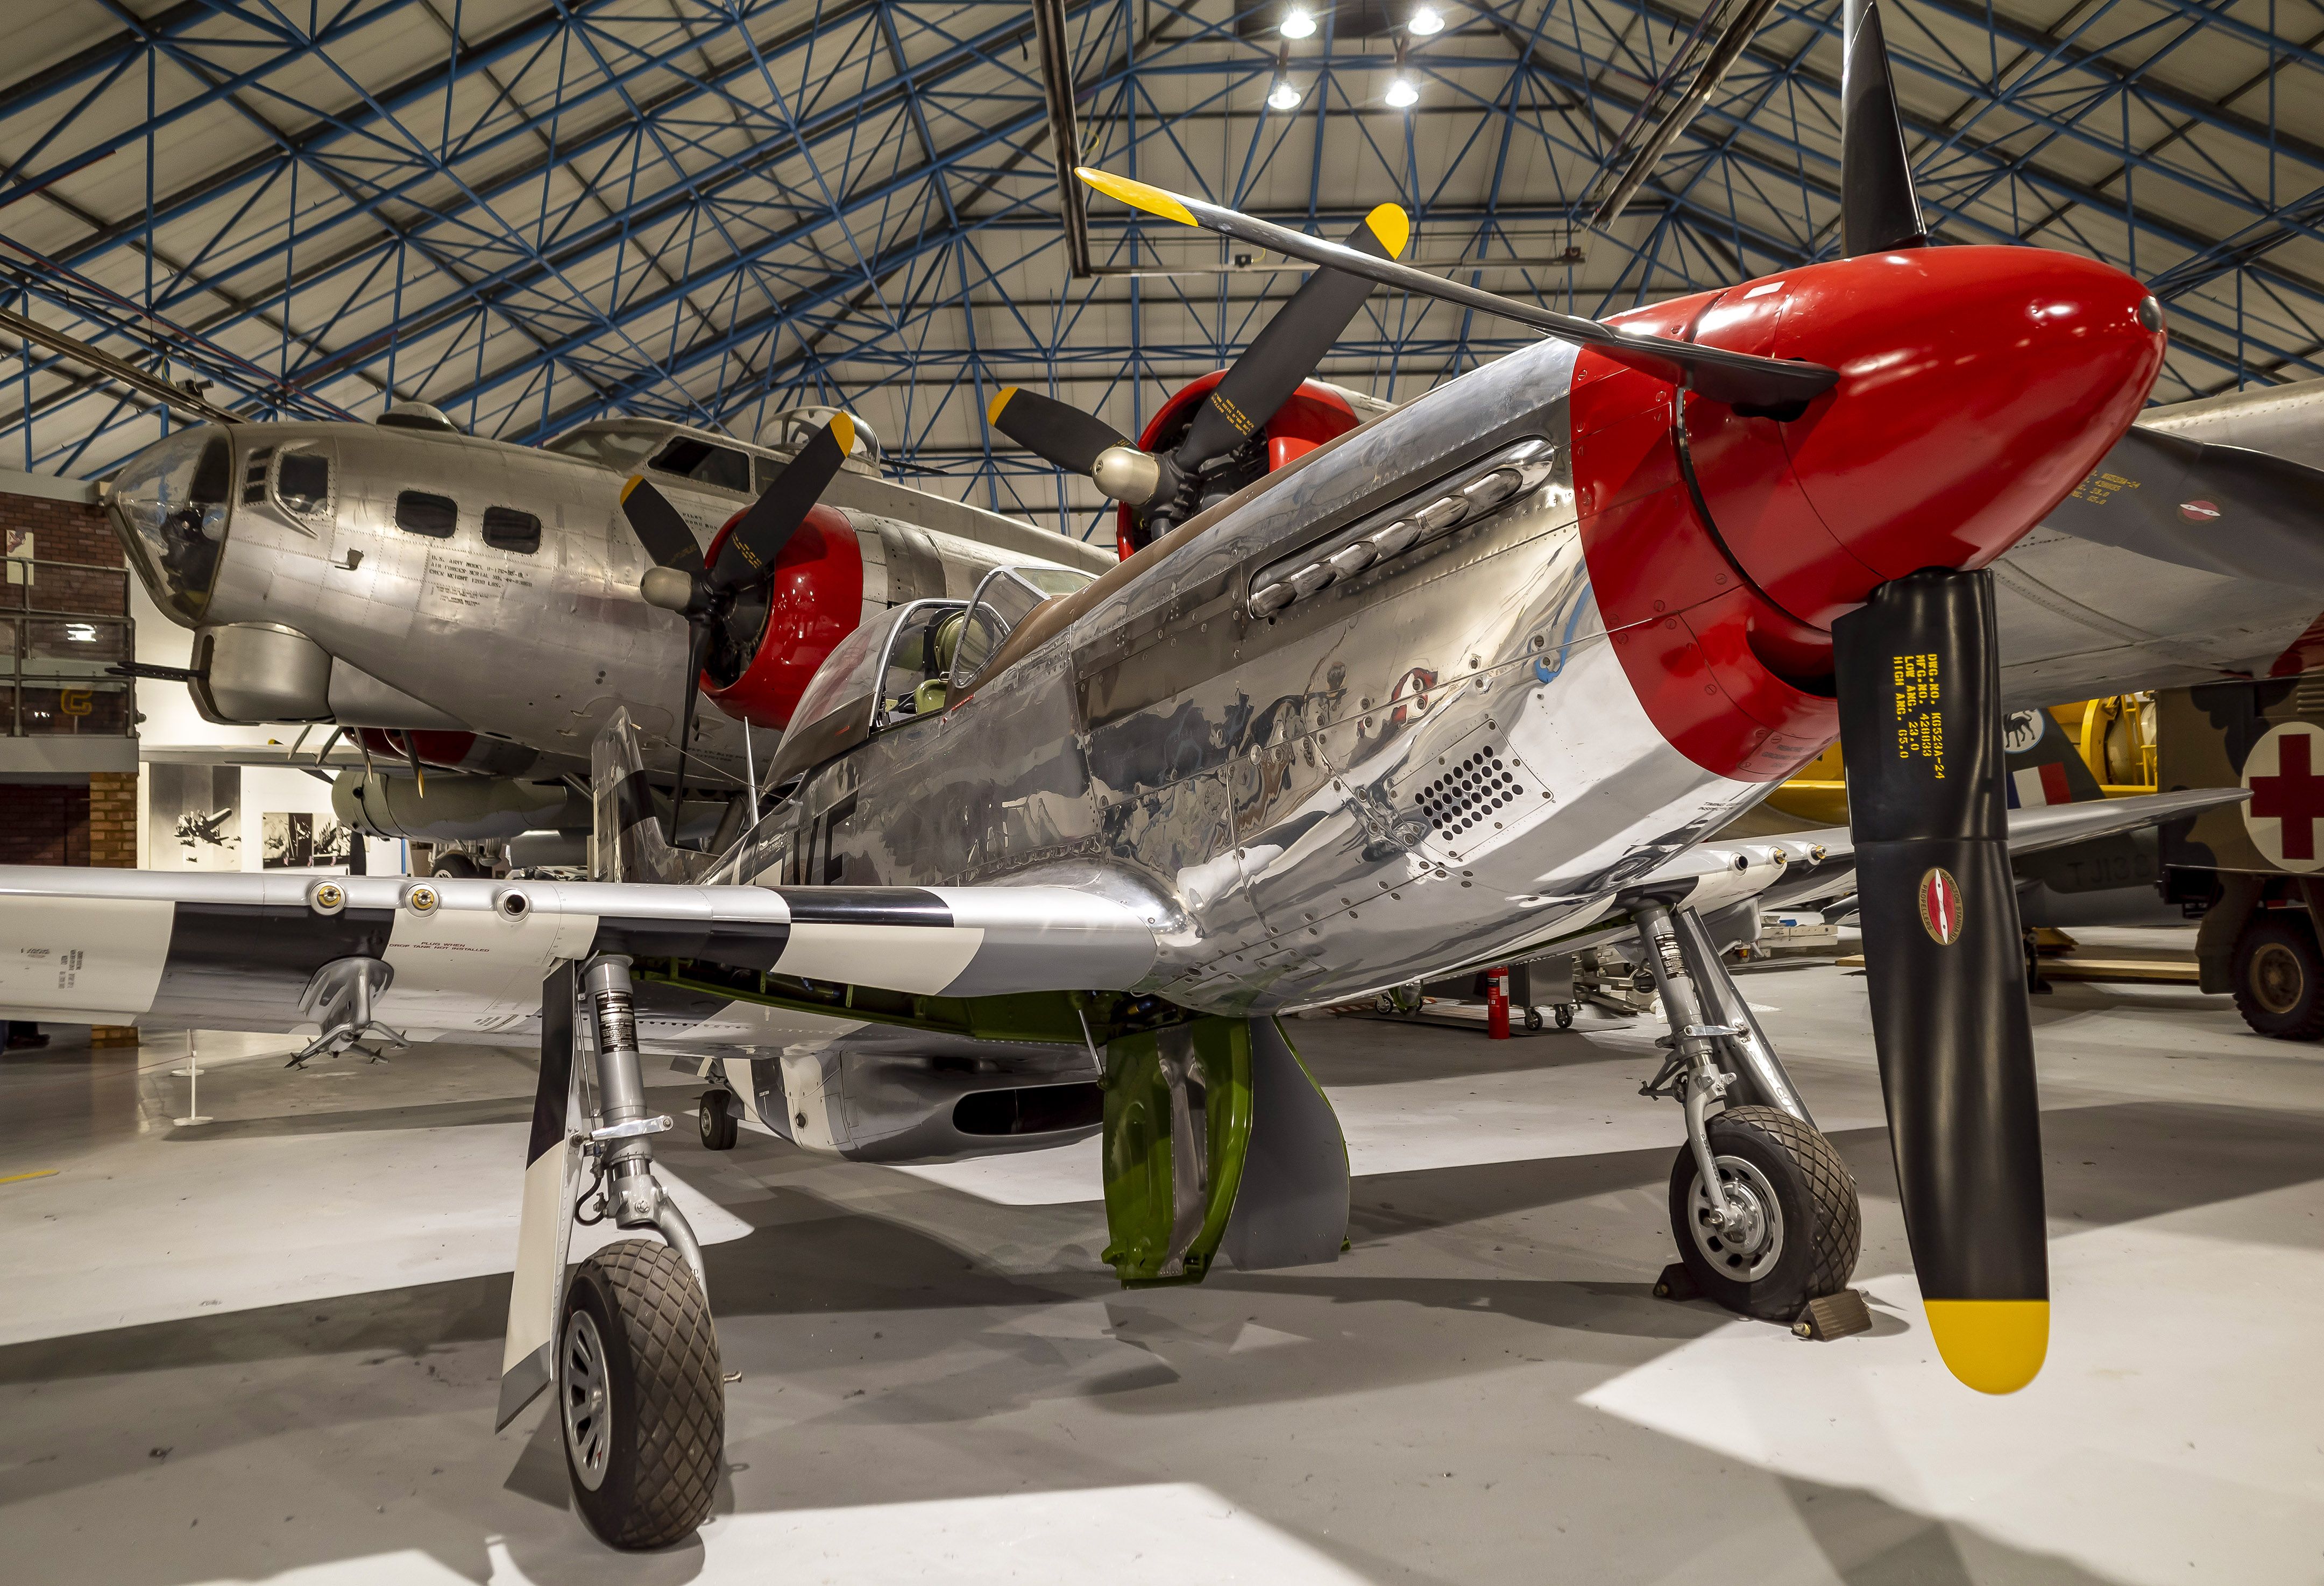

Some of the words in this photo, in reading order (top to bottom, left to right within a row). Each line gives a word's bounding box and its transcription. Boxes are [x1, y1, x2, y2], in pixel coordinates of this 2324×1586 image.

[444, 565, 467, 574] FORCES
[469, 570, 490, 579] SERIAL
[447, 572, 469, 582] WEIGHT
[466, 562, 484, 570] MODEL
[1893, 656, 1905, 686] HIGH
[1904, 656, 1916, 678] LOW
[1908, 721, 1920, 751] 23.0
[1921, 884, 1932, 930] PROPELLERS
